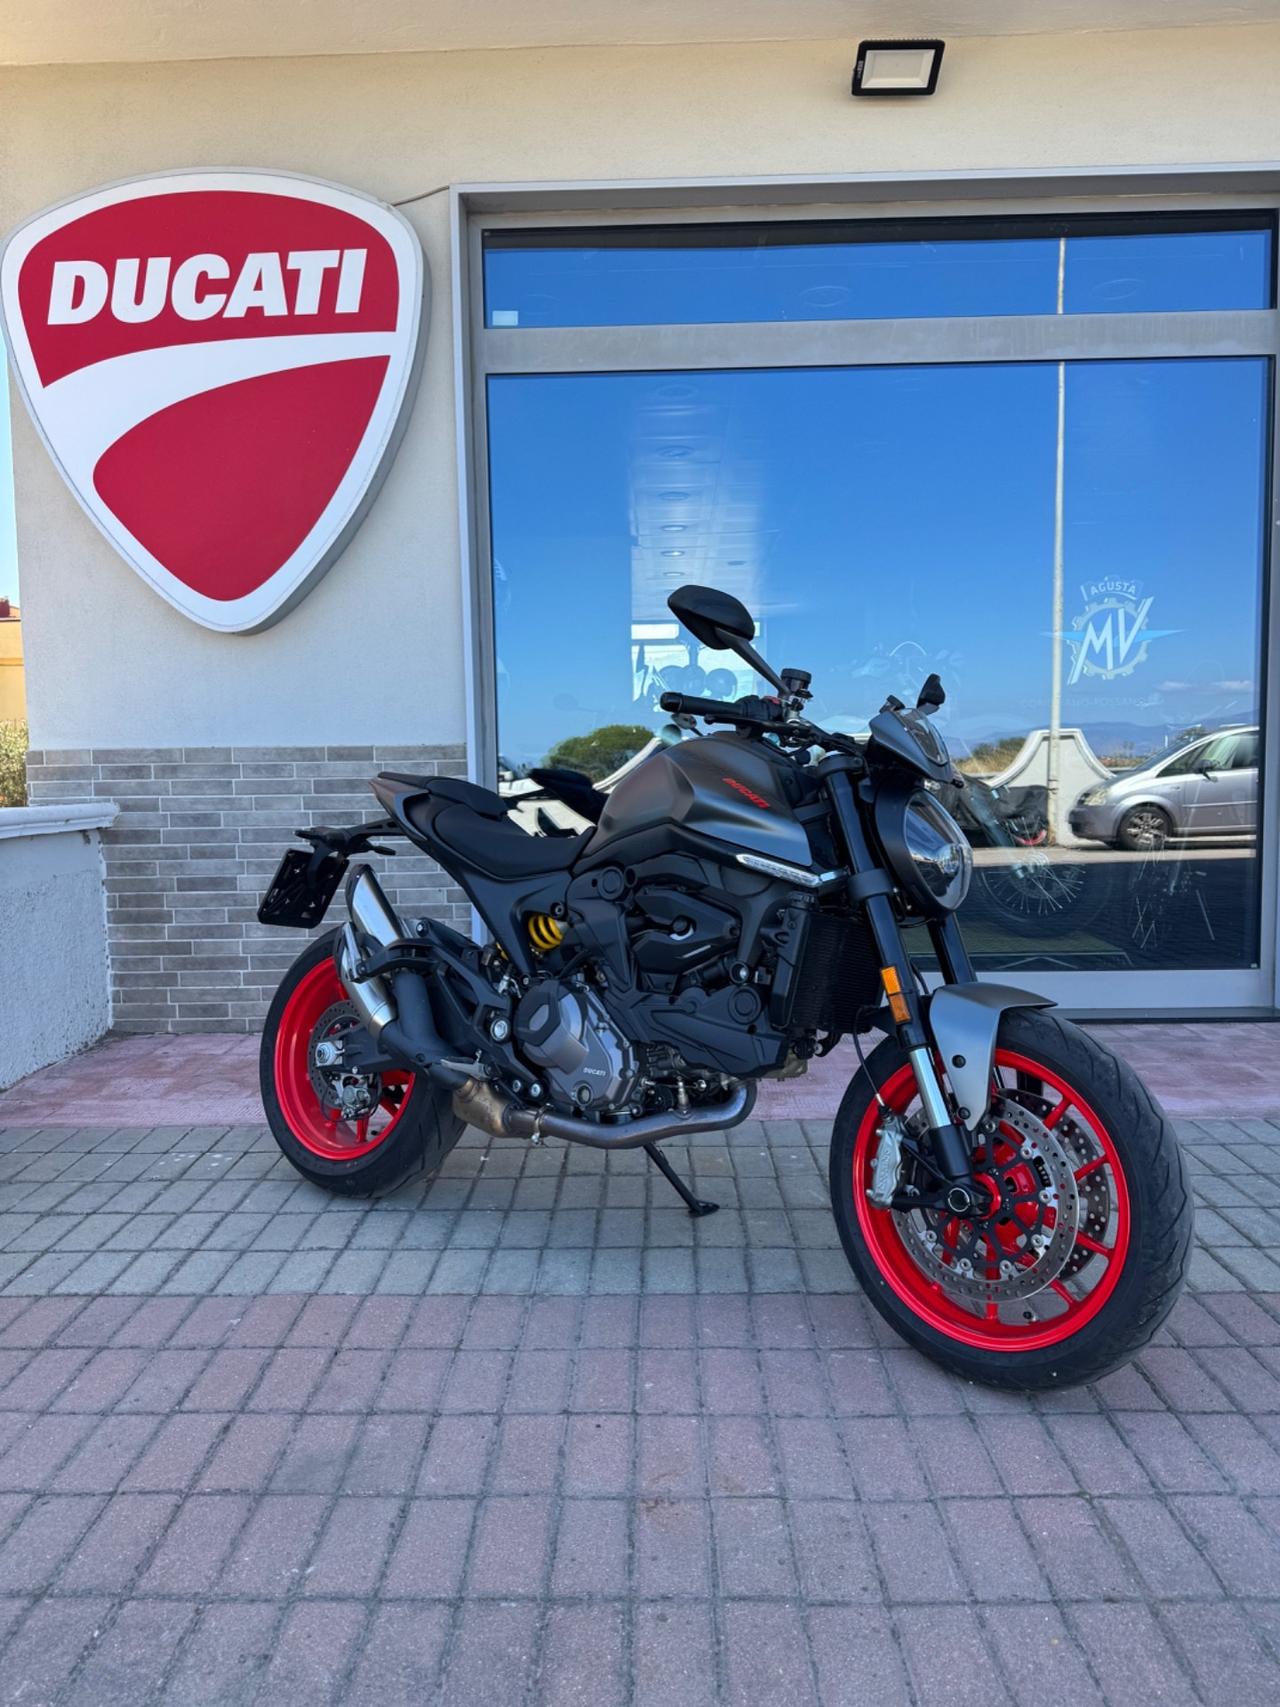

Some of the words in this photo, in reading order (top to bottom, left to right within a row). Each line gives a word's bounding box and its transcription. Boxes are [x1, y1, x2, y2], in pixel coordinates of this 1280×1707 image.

[47, 248, 368, 325] DUCATI
[1090, 581, 1136, 595] AGUSTA
[1067, 596, 1154, 685] MV
[583, 1067, 607, 1077] DUCATI
